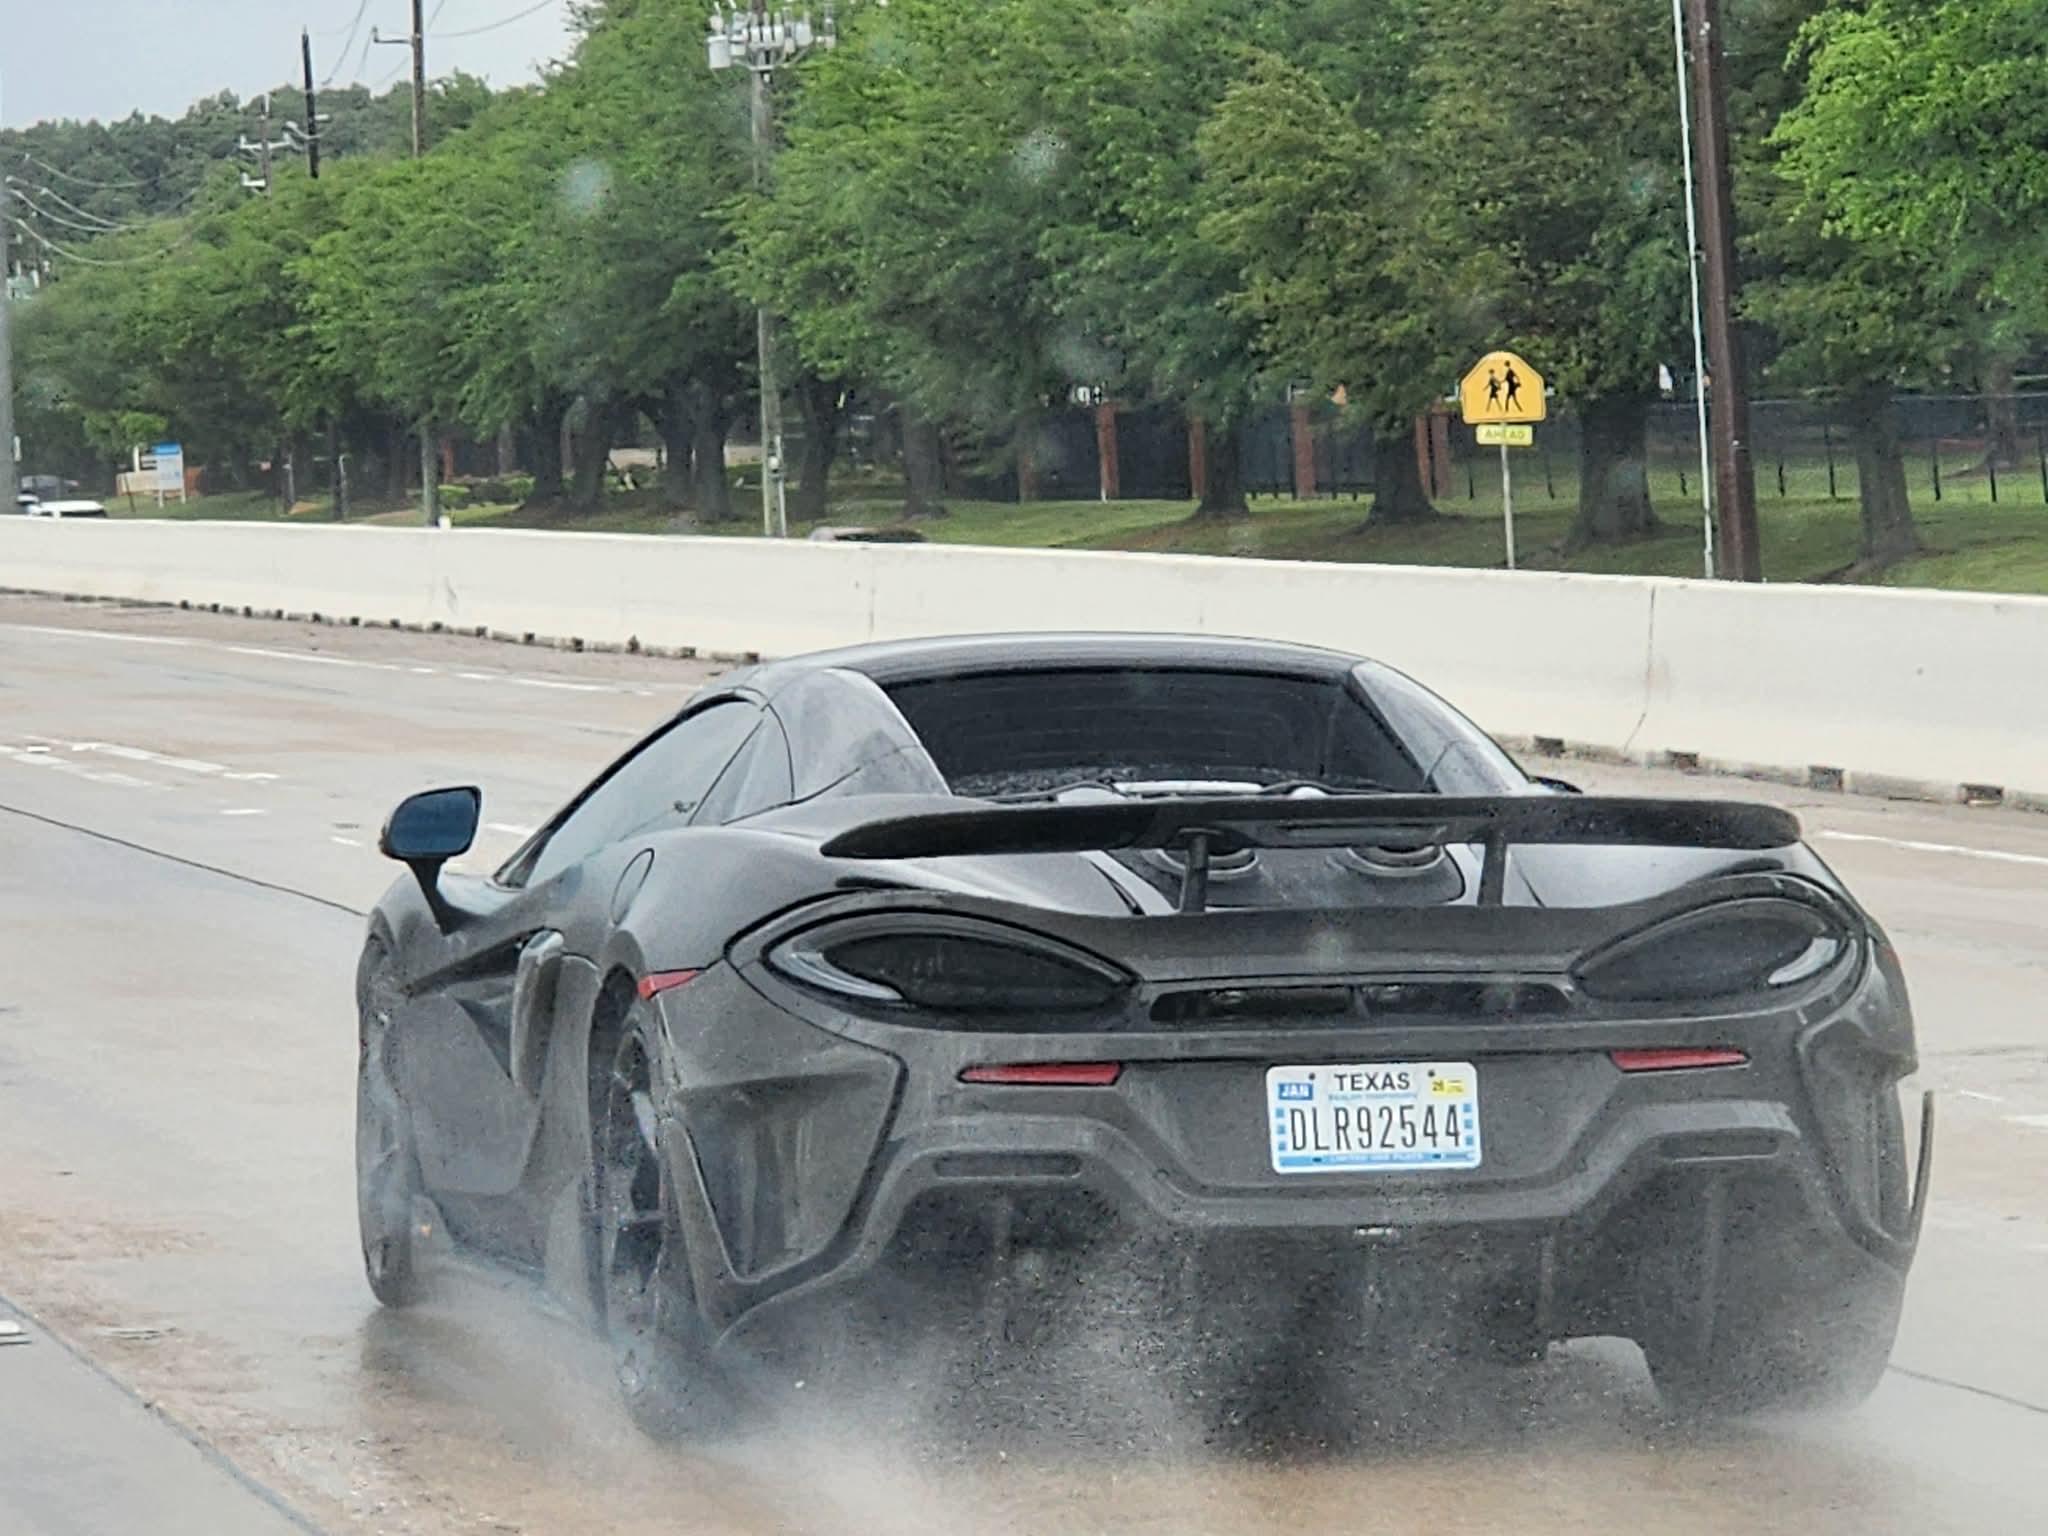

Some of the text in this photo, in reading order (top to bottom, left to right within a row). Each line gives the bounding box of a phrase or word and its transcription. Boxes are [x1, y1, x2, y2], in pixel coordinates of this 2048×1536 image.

[1281, 1084, 1310, 1098] JAN
[1334, 1072, 1411, 1091] TEXAS
[1290, 1104, 1461, 1151] DLR92544
